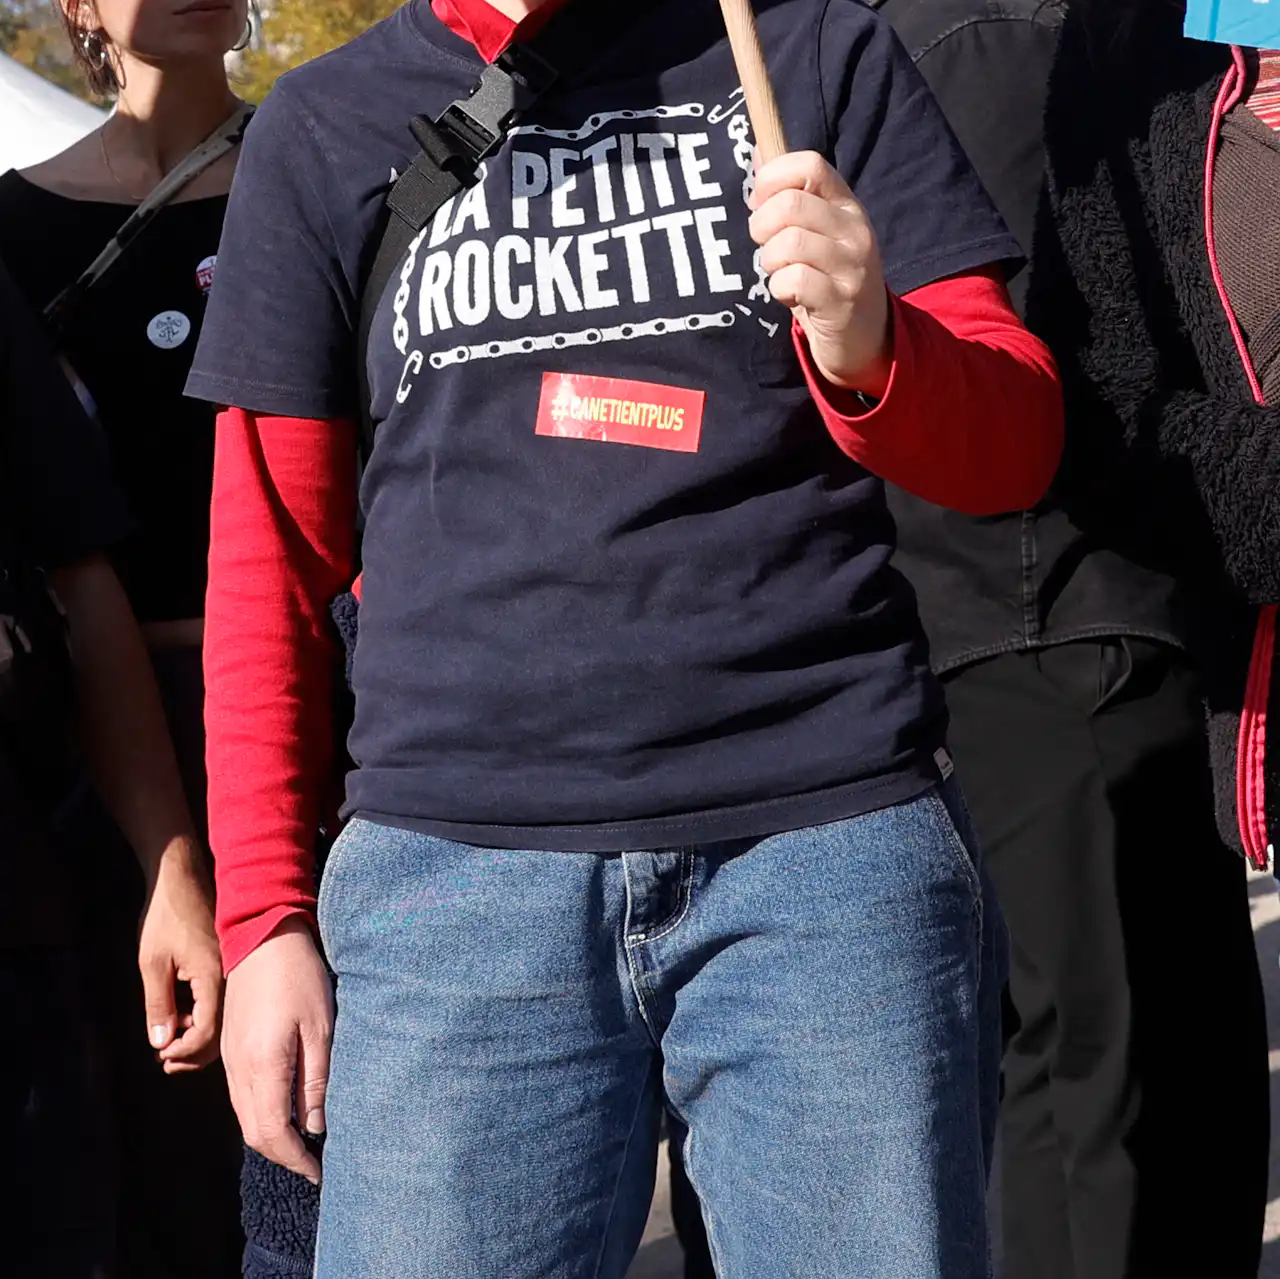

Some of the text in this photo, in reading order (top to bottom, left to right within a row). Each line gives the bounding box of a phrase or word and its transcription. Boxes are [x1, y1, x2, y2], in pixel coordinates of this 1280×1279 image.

[426, 132, 722, 249] LA PETITE
[419, 205, 744, 337] ROCKETTE
[550, 393, 686, 432] #CANETIENTPLUS
